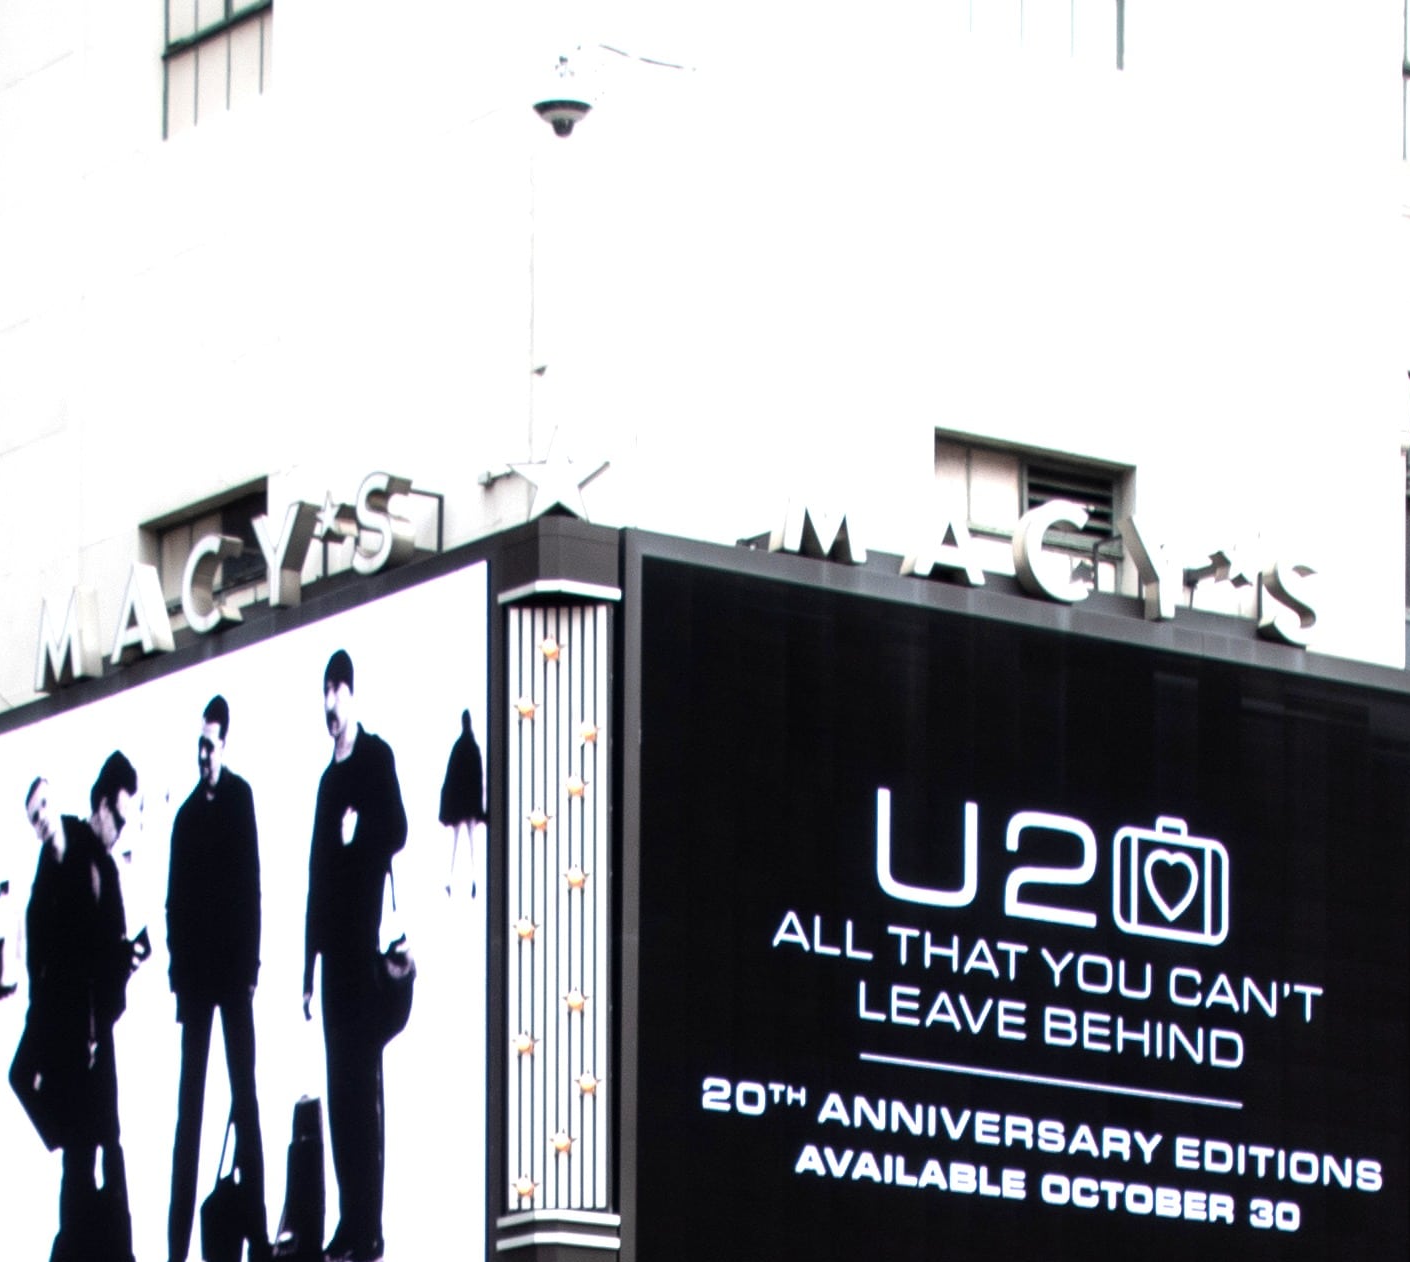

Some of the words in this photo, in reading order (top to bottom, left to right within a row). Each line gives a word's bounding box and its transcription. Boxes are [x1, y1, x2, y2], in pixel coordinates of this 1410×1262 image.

[876, 787, 1098, 929] U2
[772, 910, 874, 961] ALL
[887, 925, 1029, 982] THAT
[1040, 947, 1152, 1000] YOU
[1168, 966, 1324, 1023] CAN'T
[858, 980, 1027, 1041] LEAVE
[1043, 1005, 1244, 1069] BEHIND
[794, 1144, 1027, 1201] AVAILABLE
[1040, 1173, 1235, 1225] OCTOBER
[1249, 1197, 1301, 1232] 30
[817, 1092, 1163, 1163] ANNIVERSARY
[1174, 1135, 1383, 1192] EDITIONS
